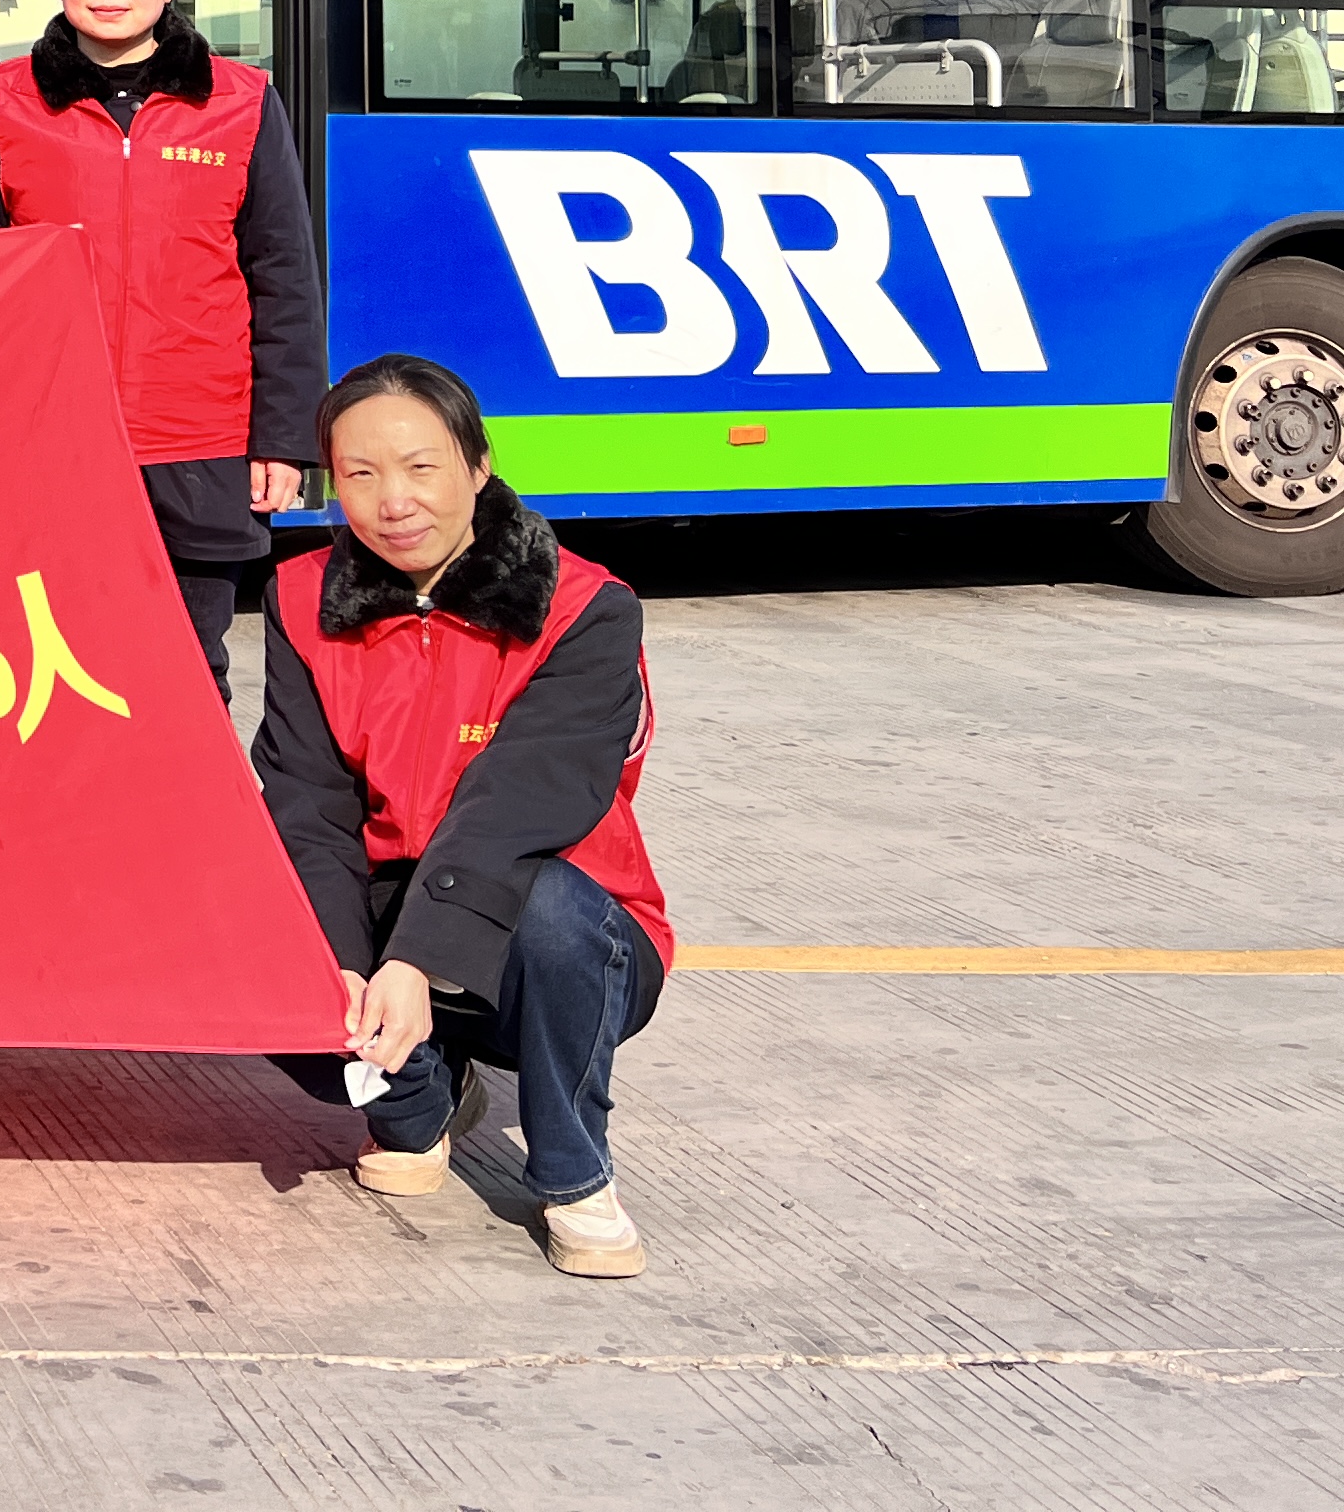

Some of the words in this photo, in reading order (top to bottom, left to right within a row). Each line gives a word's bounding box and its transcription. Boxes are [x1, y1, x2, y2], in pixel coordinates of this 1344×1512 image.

[161, 146, 226, 167] 连云港公交
[469, 149, 1049, 378] BRT
